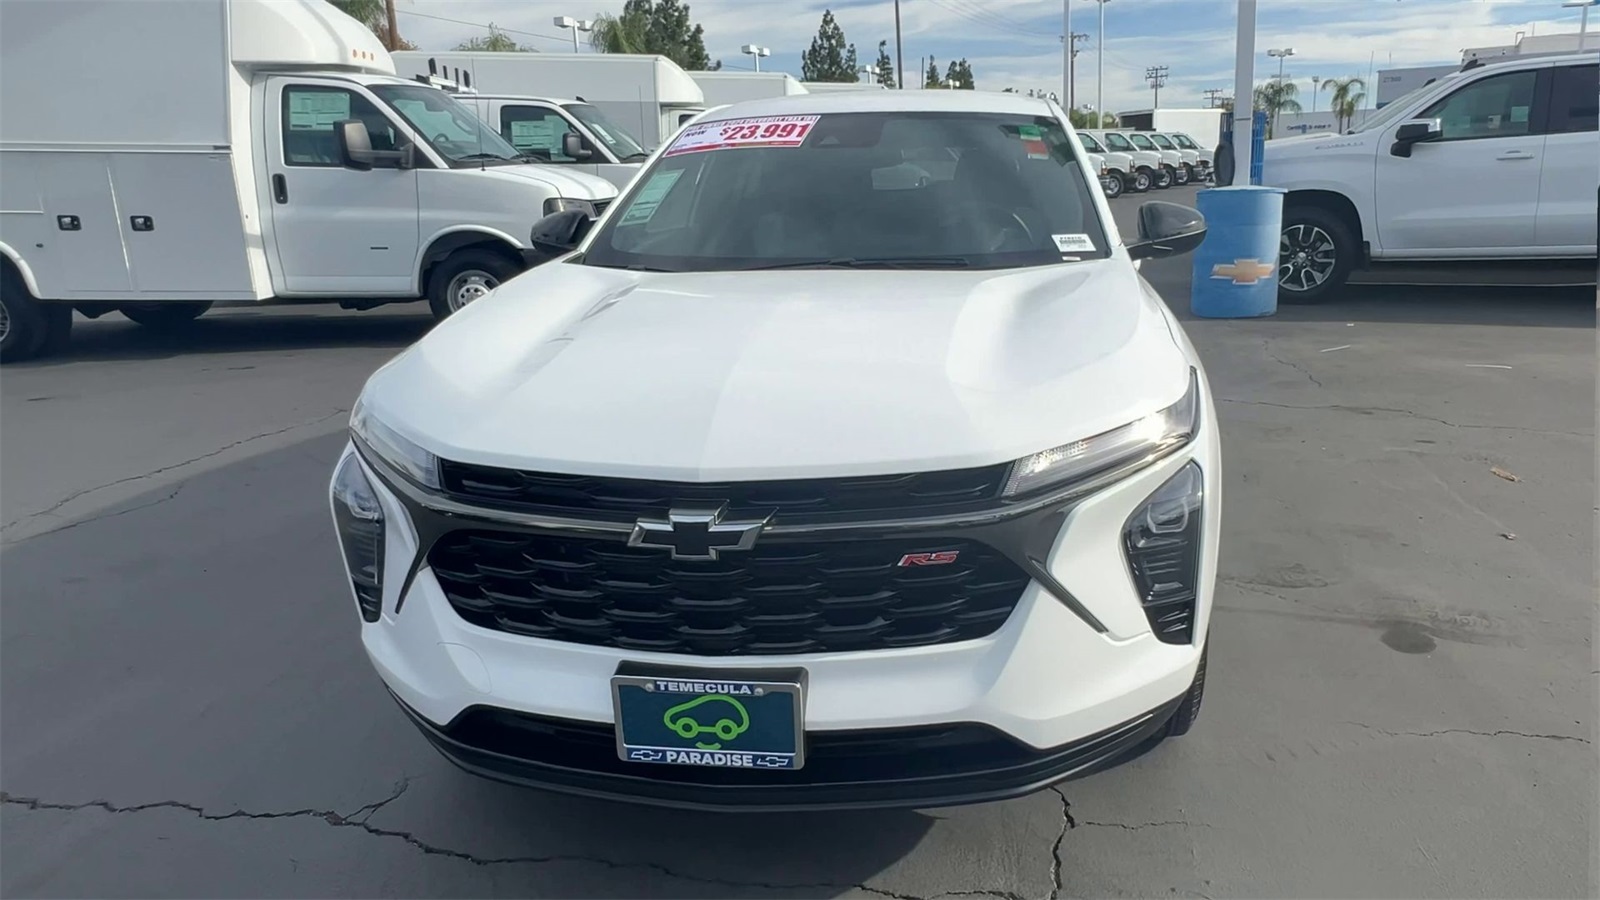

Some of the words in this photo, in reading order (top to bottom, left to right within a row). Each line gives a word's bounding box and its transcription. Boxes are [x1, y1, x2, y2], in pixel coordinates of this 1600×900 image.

[897, 550, 960, 567] RS
[656, 681, 751, 694] TEMECULA
[666, 751, 753, 766] PARADISE
